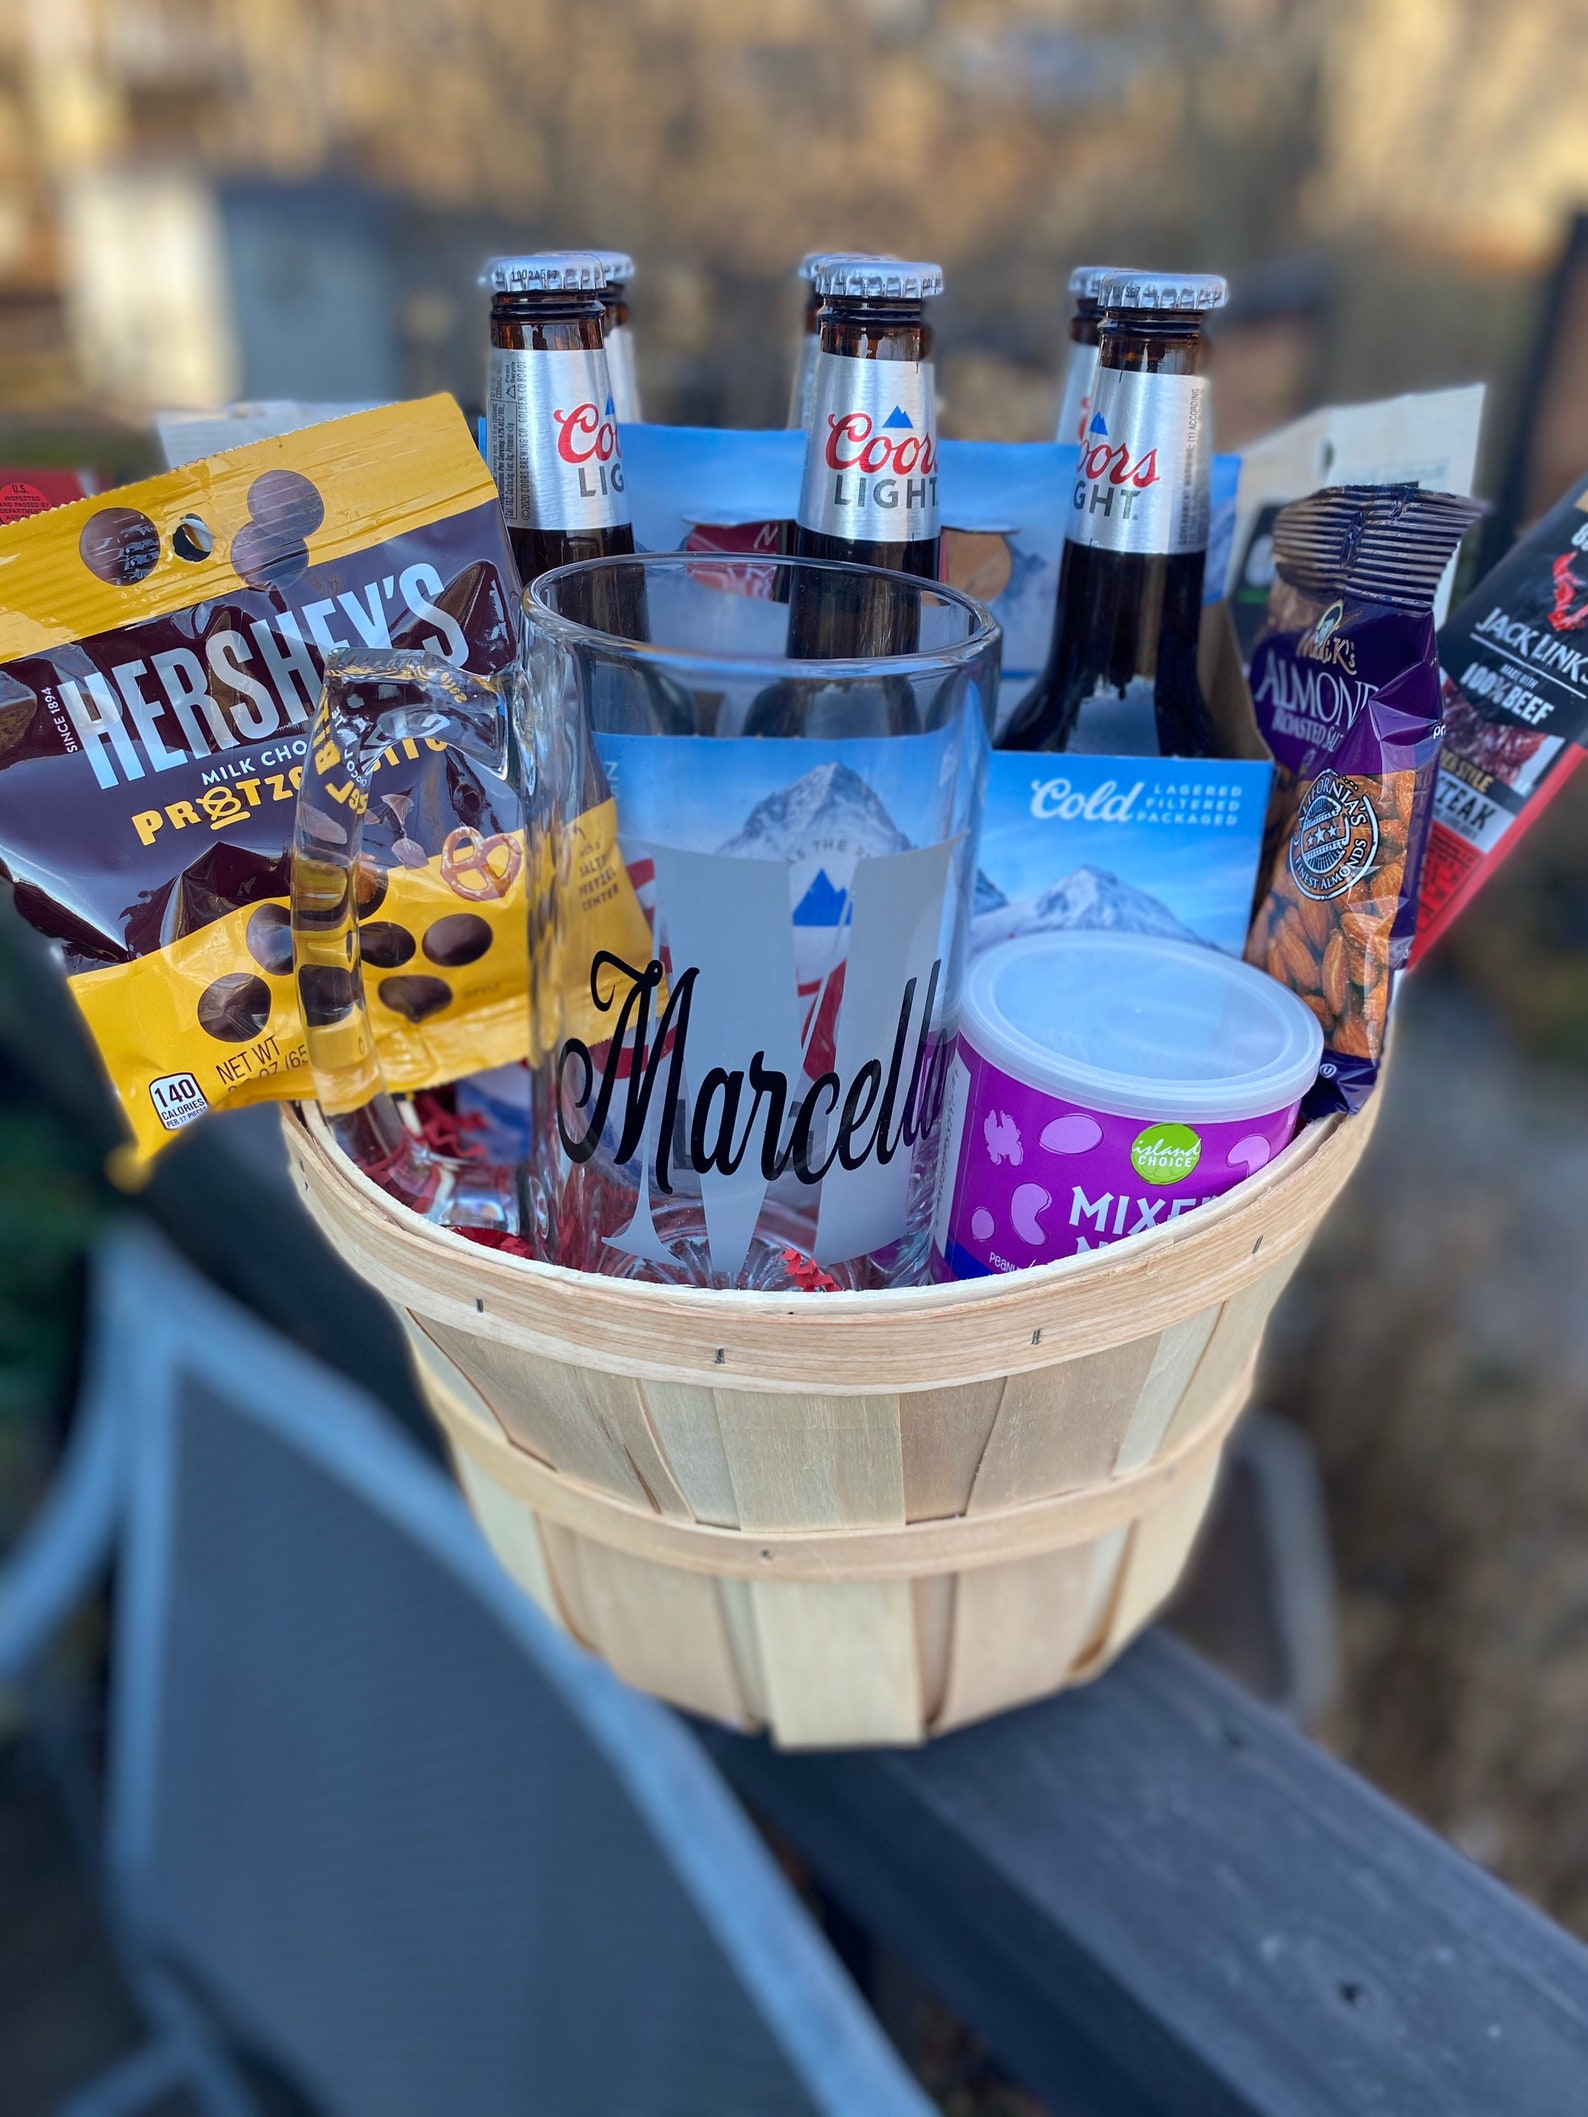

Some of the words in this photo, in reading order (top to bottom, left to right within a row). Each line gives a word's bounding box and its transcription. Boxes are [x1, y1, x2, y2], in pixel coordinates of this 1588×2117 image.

[1189, 388, 1200, 430] ACCORDING
[553, 403, 621, 463] Co
[826, 412, 938, 475] Coor
[519, 439, 529, 469] BREWING
[520, 470, 530, 492] COORS
[1475, 607, 1539, 657] JACK
[1531, 634, 1588, 686] LINK
[41, 687, 61, 714] 1894
[1460, 662, 1508, 704] 100%
[1501, 684, 1555, 726] BEEF
[53, 716, 78, 753] SINCE
[1323, 726, 1344, 752] SAL
[202, 758, 256, 785] MILK
[1457, 761, 1495, 793] STYLE
[1030, 778, 1145, 822] Cold
[1146, 797, 1240, 812] FILTERED
[1154, 784, 1242, 797] LAGERED
[1436, 776, 1496, 831] TEAK
[1137, 811, 1238, 826] PACKAGED
[1321, 840, 1367, 890] ALMONDS
[216, 1051, 252, 1084] NET
[252, 1035, 281, 1065] WT
[154, 1078, 197, 1107] 140
[161, 1098, 205, 1121] CALORIES
[166, 1116, 180, 1128] PER
[180, 1111, 188, 1123] 17
[1132, 1138, 1202, 1157] island
[1138, 1155, 1193, 1168] CHOICE
[1069, 1186, 1219, 1236] MIX
